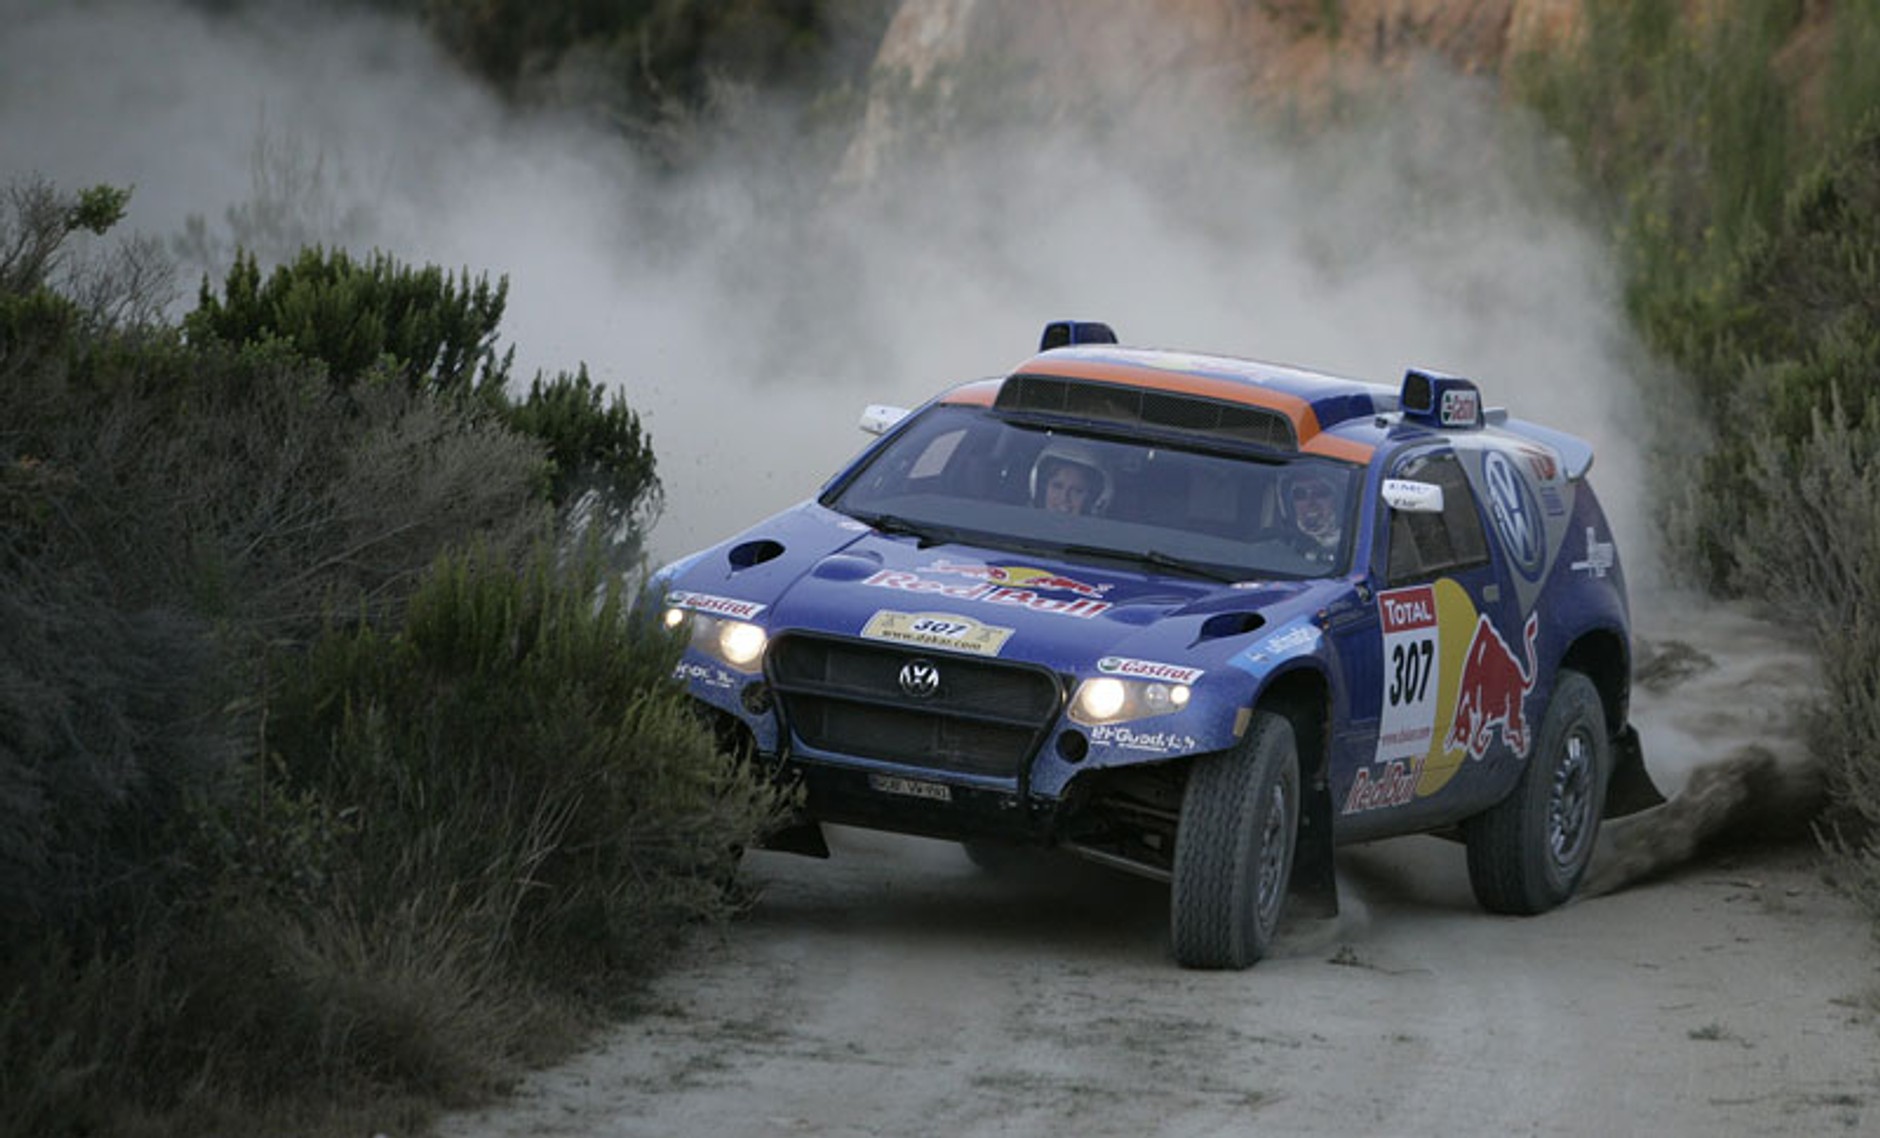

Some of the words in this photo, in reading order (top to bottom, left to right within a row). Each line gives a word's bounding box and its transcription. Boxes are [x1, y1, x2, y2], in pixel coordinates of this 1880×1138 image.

[861, 569, 992, 600] Red
[981, 586, 1113, 620] Bull
[686, 596, 755, 617] Castrol
[913, 619, 968, 637] 307
[881, 629, 982, 652] www.dakar.com
[1120, 659, 1196, 682] Castrol
[1388, 639, 1435, 708] 307
[1341, 761, 1394, 815] Red
[1388, 753, 1427, 808] Bull
